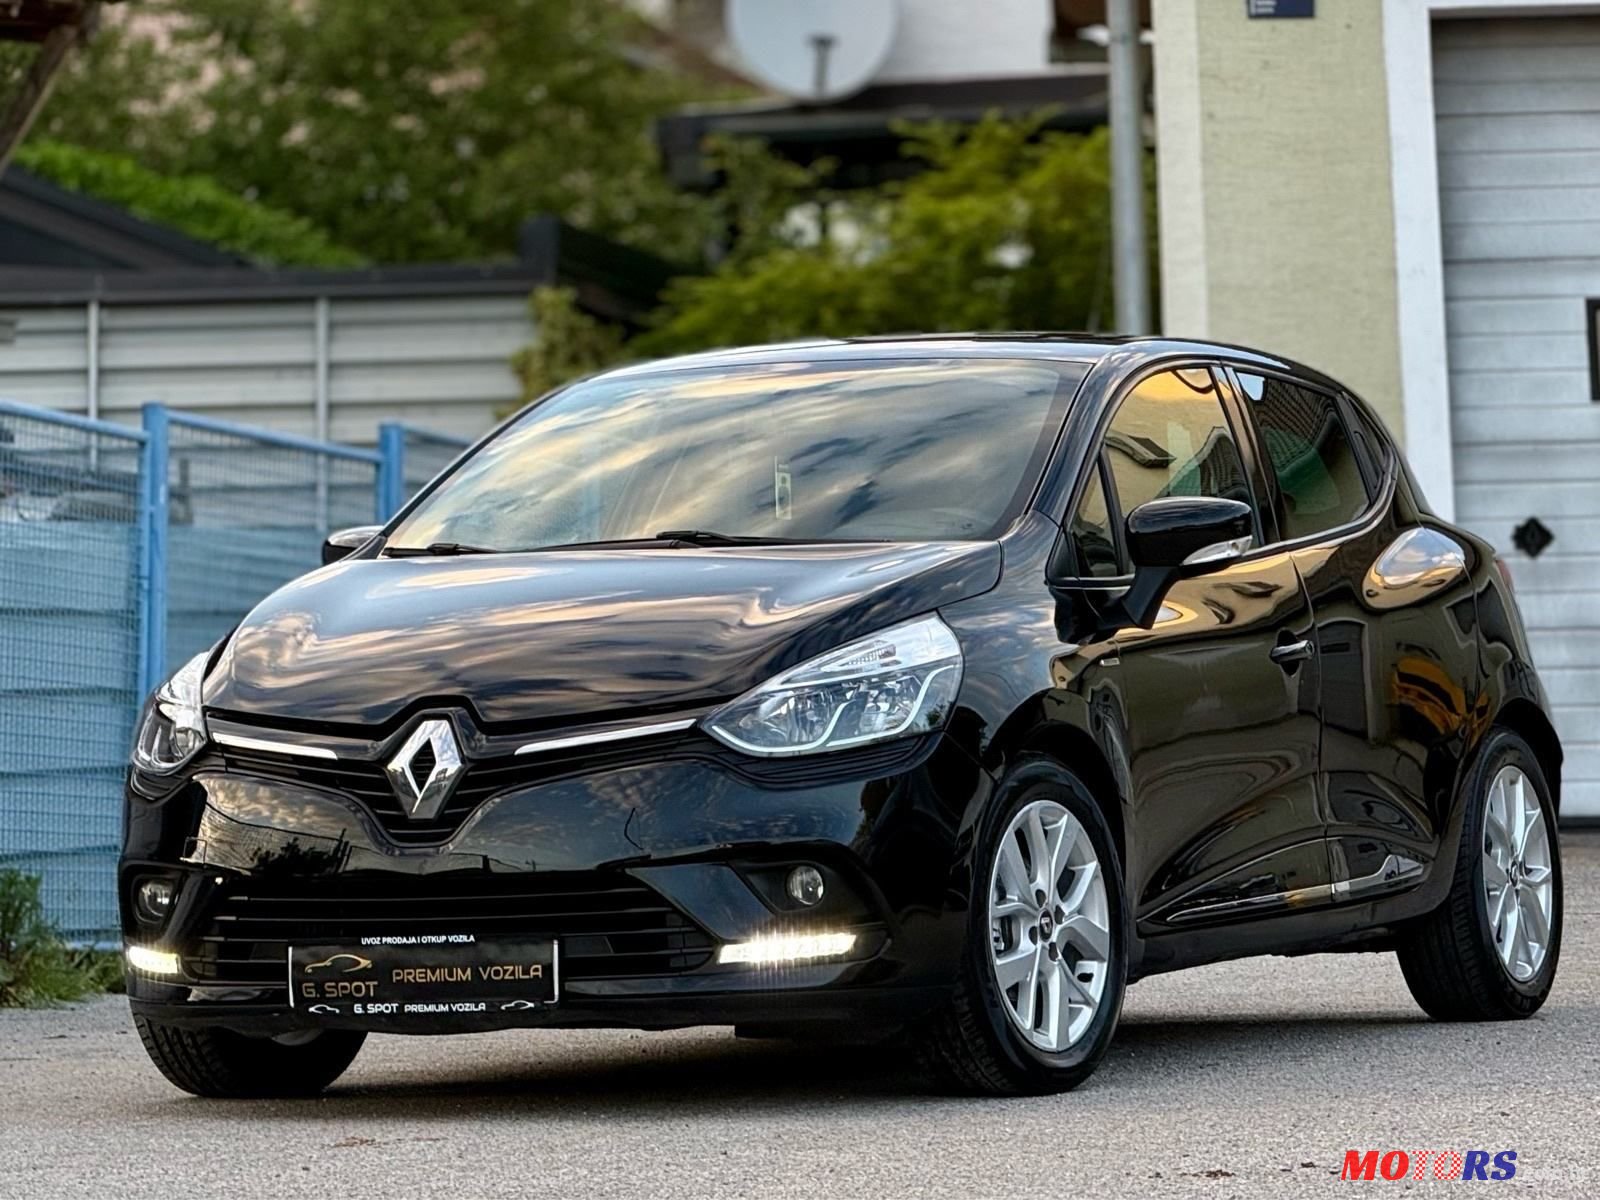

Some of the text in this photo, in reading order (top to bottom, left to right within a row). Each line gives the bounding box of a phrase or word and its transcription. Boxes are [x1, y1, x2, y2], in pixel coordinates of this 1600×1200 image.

[361, 937, 381, 945] UVOZ
[382, 936, 417, 945] PRODAJA
[421, 935, 447, 944] OTKUP
[447, 934, 475, 943] VOZILA
[392, 964, 543, 983] PREMIUM VOZILA
[302, 981, 378, 998] G. SPOT
[353, 1002, 486, 1014] G. SPOT PREMIUM VOZILA
